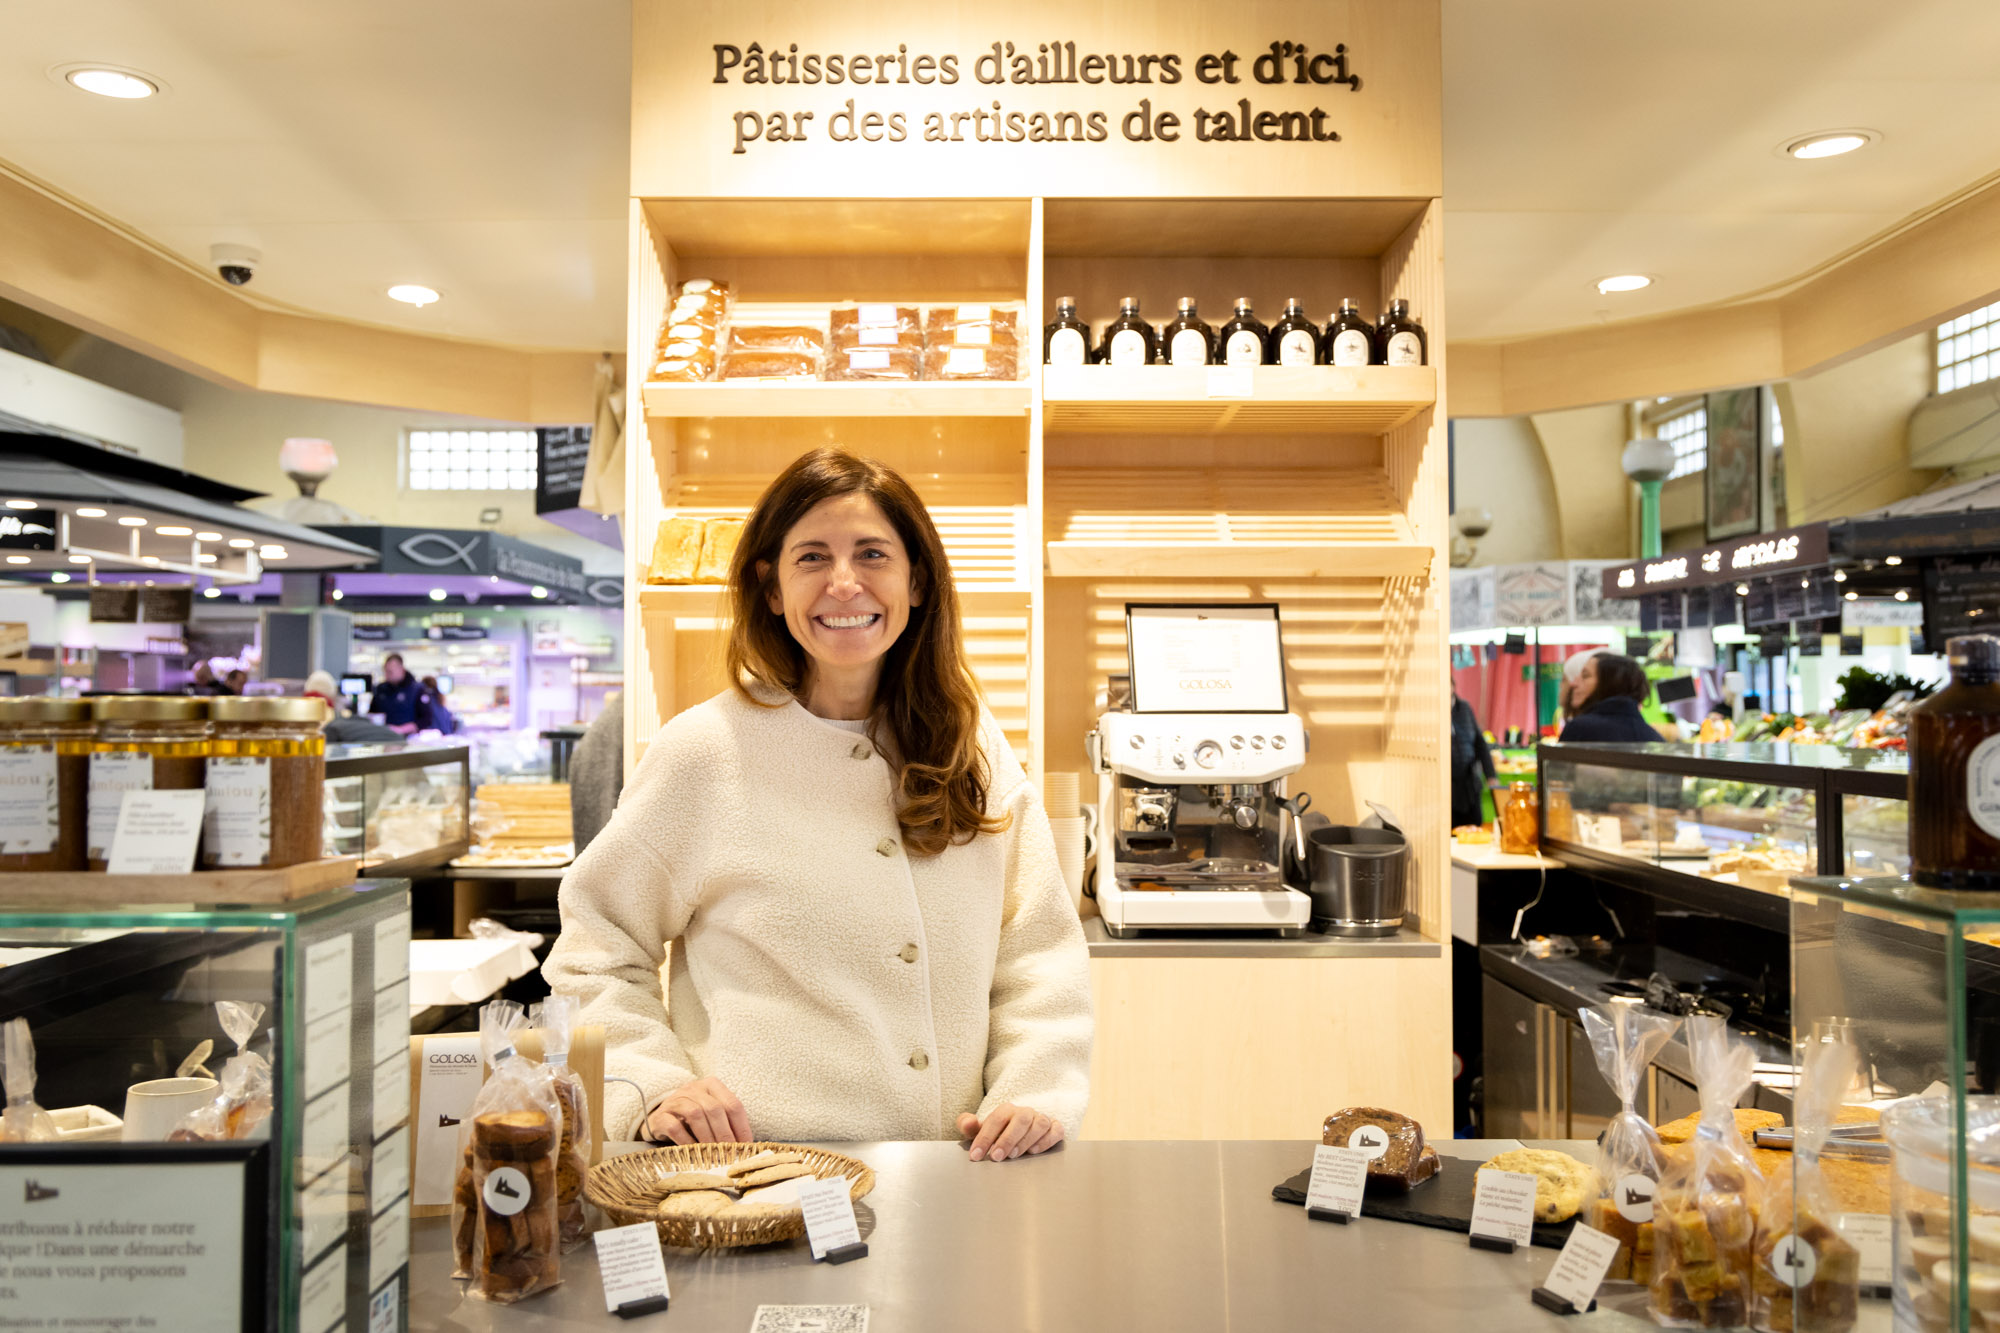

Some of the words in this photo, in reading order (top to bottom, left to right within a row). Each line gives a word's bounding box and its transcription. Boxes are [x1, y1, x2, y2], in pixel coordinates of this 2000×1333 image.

[712, 41, 959, 84] Pâtisseries
[1195, 49, 1242, 84] et
[732, 110, 814, 154] par
[828, 98, 908, 142] des
[923, 99, 1108, 142] artisans
[1121, 98, 1181, 142] de
[1193, 98, 1342, 142] talent.
[1178, 679, 1232, 690] GOLOSA
[429, 1053, 478, 1064] GOLOSA
[74, 1220, 83, 1236] à
[87, 1219, 147, 1236] réduire
[152, 1223, 196, 1236] notre
[89, 1245, 119, 1257] une
[123, 1239, 205, 1257] démarche
[13, 1267, 51, 1278] nous
[57, 1267, 95, 1278] vous
[100, 1266, 187, 1282] proposons
[46, 1317, 60, 1328] et
[62, 1317, 132, 1330] encourager
[135, 1315, 157, 1328] des
